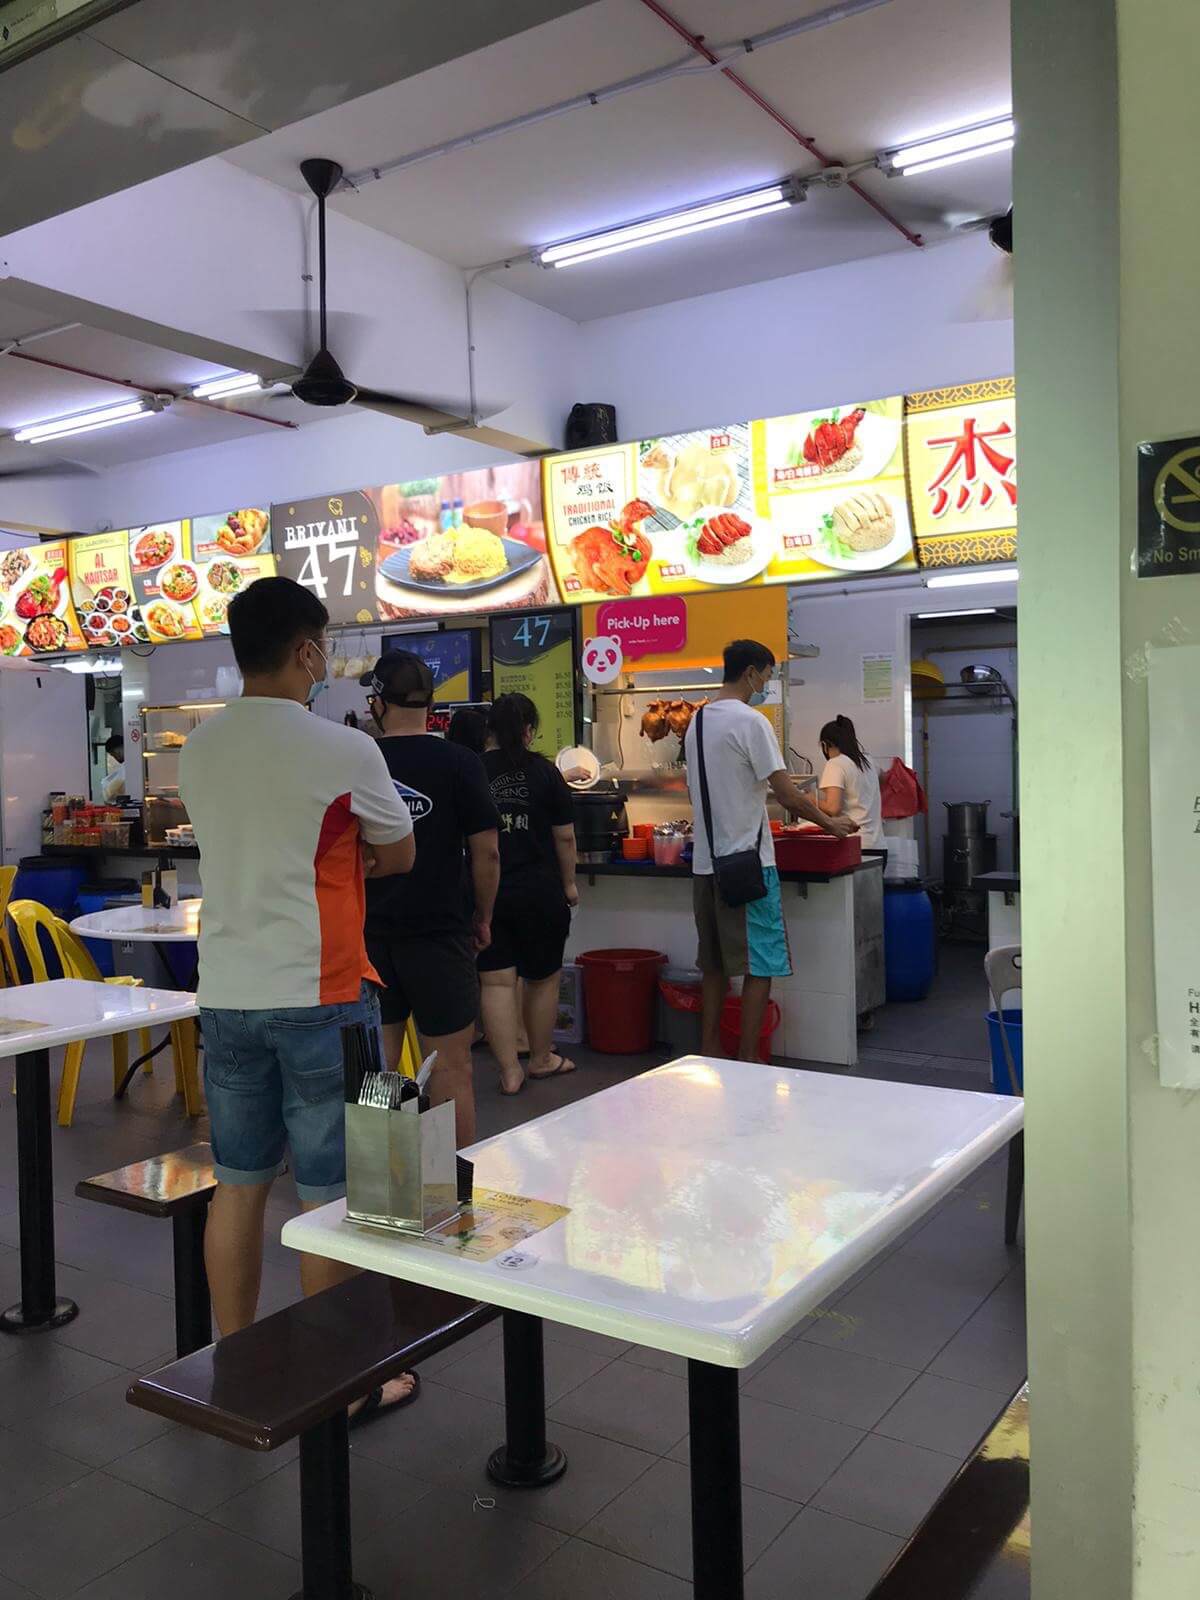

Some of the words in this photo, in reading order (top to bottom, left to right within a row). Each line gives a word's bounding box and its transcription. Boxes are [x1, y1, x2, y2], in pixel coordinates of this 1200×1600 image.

[927, 418, 1016, 514] 杰
[562, 498, 616, 517] TRADITIONAL
[568, 514, 596, 527] CHICKEN
[599, 511, 612, 522] RICE
[284, 517, 358, 544] BRIYANI
[94, 552, 105, 569] AL
[1153, 548, 1174, 563] No
[83, 567, 119, 585] KAUTSAR
[296, 539, 357, 599] 47
[607, 615, 650, 630] Pick-Up
[653, 613, 680, 627] here
[512, 615, 552, 648] 47
[493, 786, 529, 801] CHENG
[500, 1255, 524, 1268] 12
